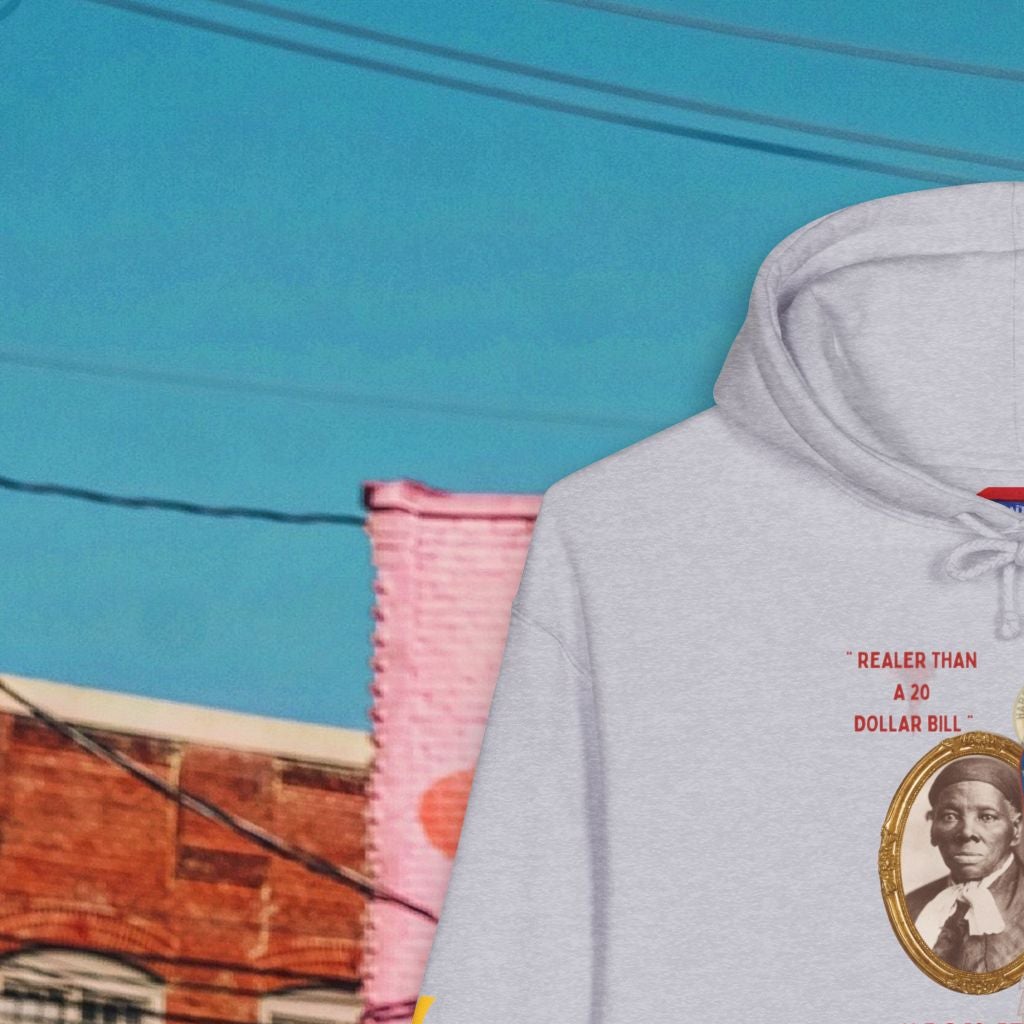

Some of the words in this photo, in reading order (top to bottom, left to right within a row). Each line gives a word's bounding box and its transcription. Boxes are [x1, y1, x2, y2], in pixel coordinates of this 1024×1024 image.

[931, 651, 977, 669] THAN
[893, 683, 905, 701] A
[910, 683, 930, 701] 20
[854, 715, 922, 732] DOLLAR
